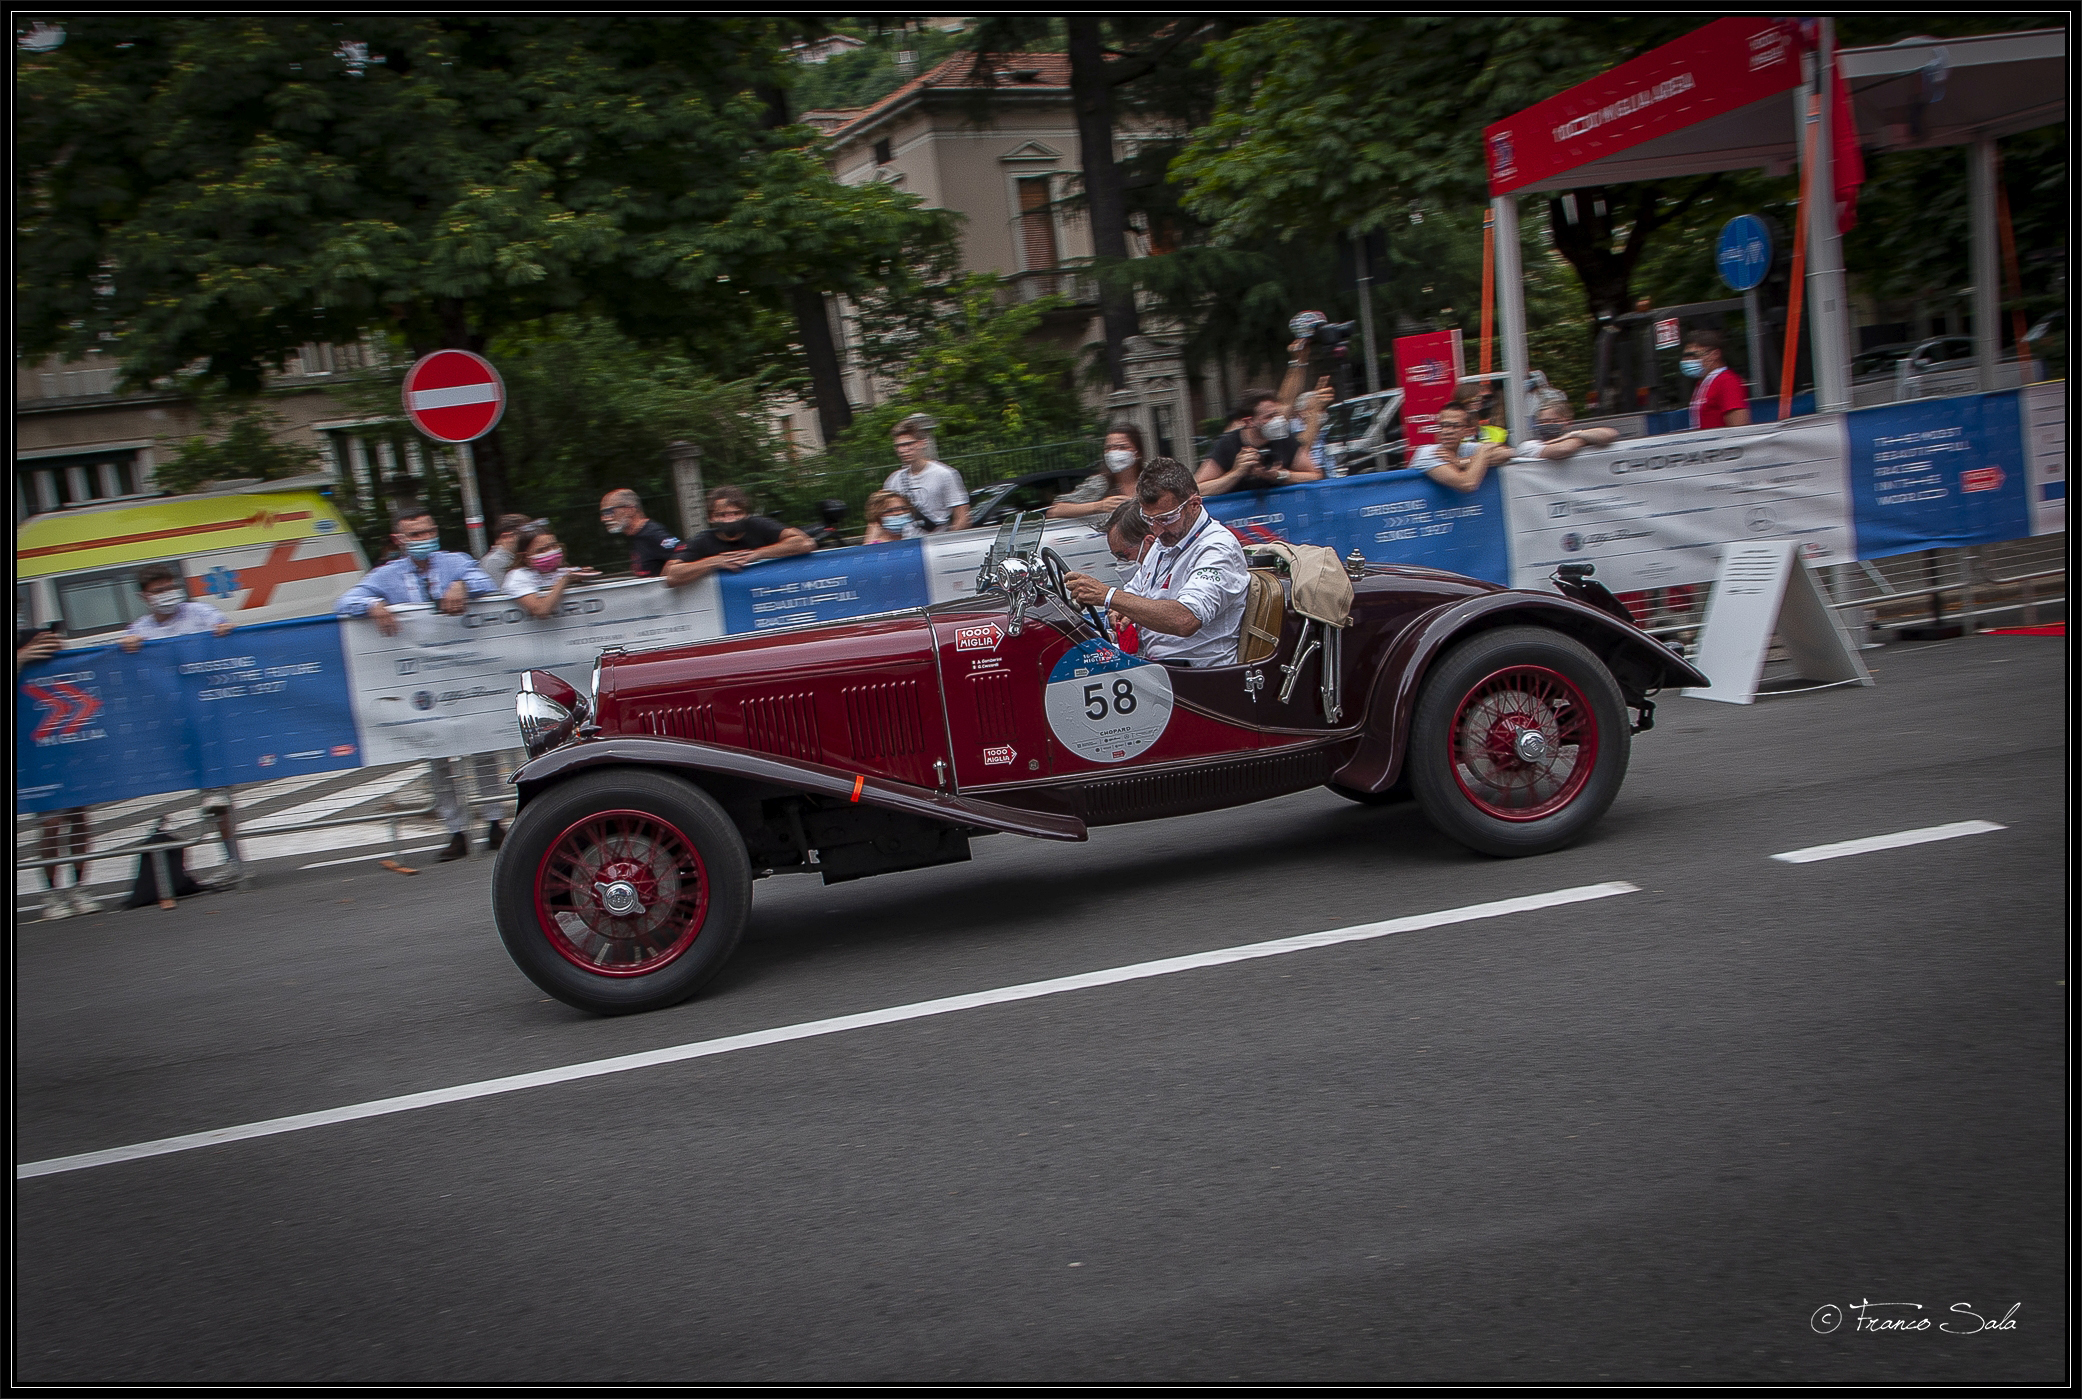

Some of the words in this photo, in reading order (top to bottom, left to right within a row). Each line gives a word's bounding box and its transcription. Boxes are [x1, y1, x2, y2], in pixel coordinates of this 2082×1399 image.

[961, 627, 990, 638] 1000
[960, 637, 993, 648] MIGLIA
[1083, 678, 1138, 721] 58
[1100, 726, 1131, 736] CHOPARD
[986, 755, 1011, 763] MIGLIA
